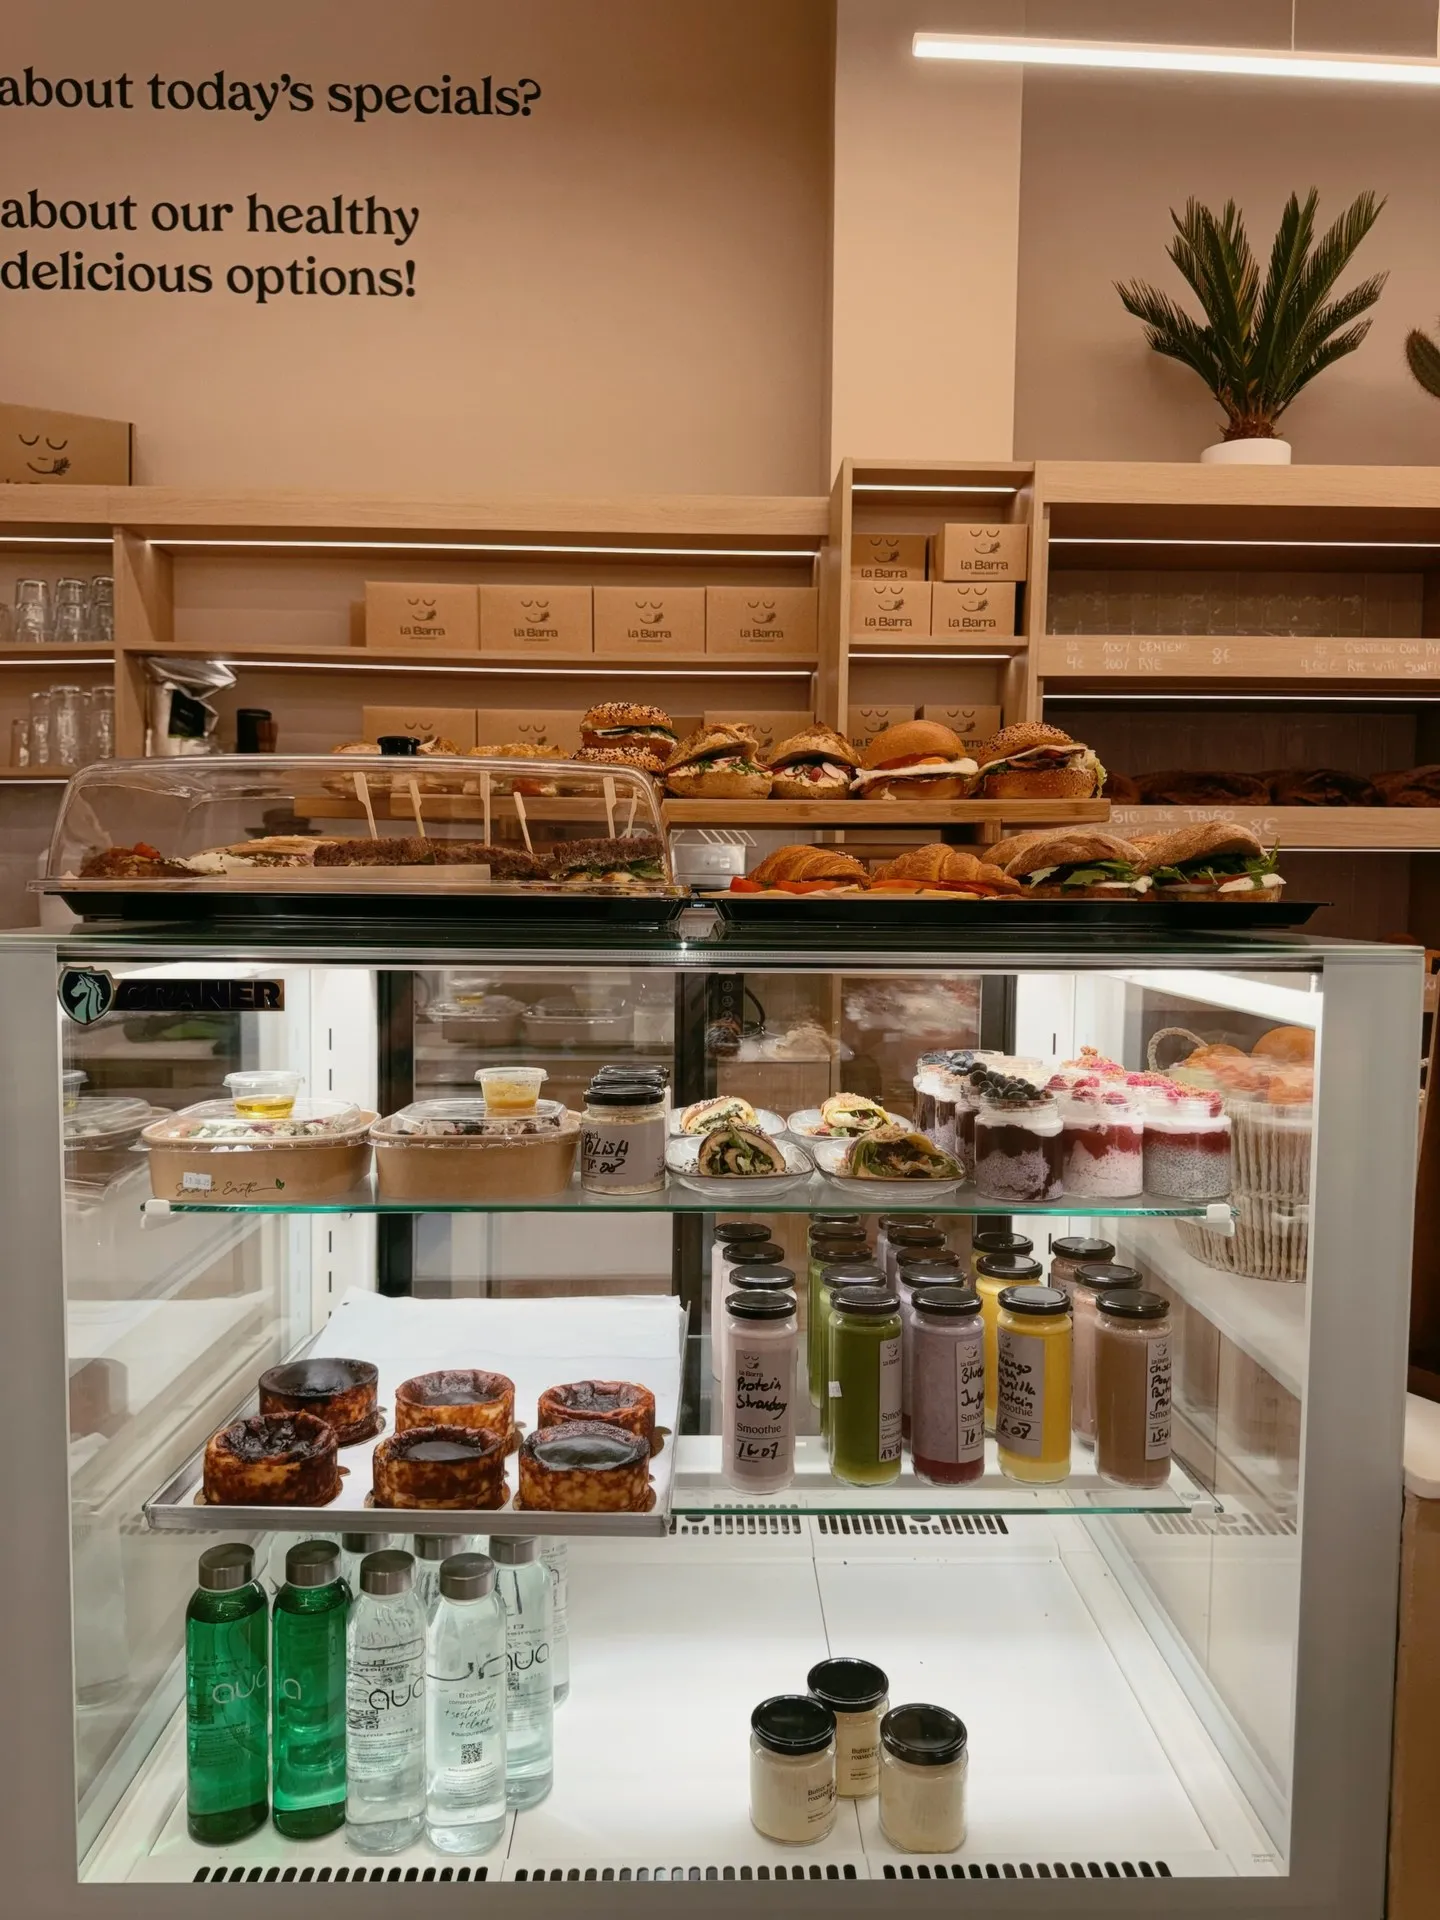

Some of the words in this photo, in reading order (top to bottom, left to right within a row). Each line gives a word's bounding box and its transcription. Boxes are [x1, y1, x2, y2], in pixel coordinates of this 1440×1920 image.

[0, 66, 134, 109] about
[327, 75, 542, 122] specials?
[1, 188, 138, 231] about
[151, 200, 234, 232] our
[247, 192, 420, 246] healthy
[1, 249, 214, 294] delicious
[226, 255, 417, 304] options!
[1137, 657, 1163, 671] RYE
[1154, 810, 1176, 822] DE
[737, 1422, 782, 1435] Smoothie
